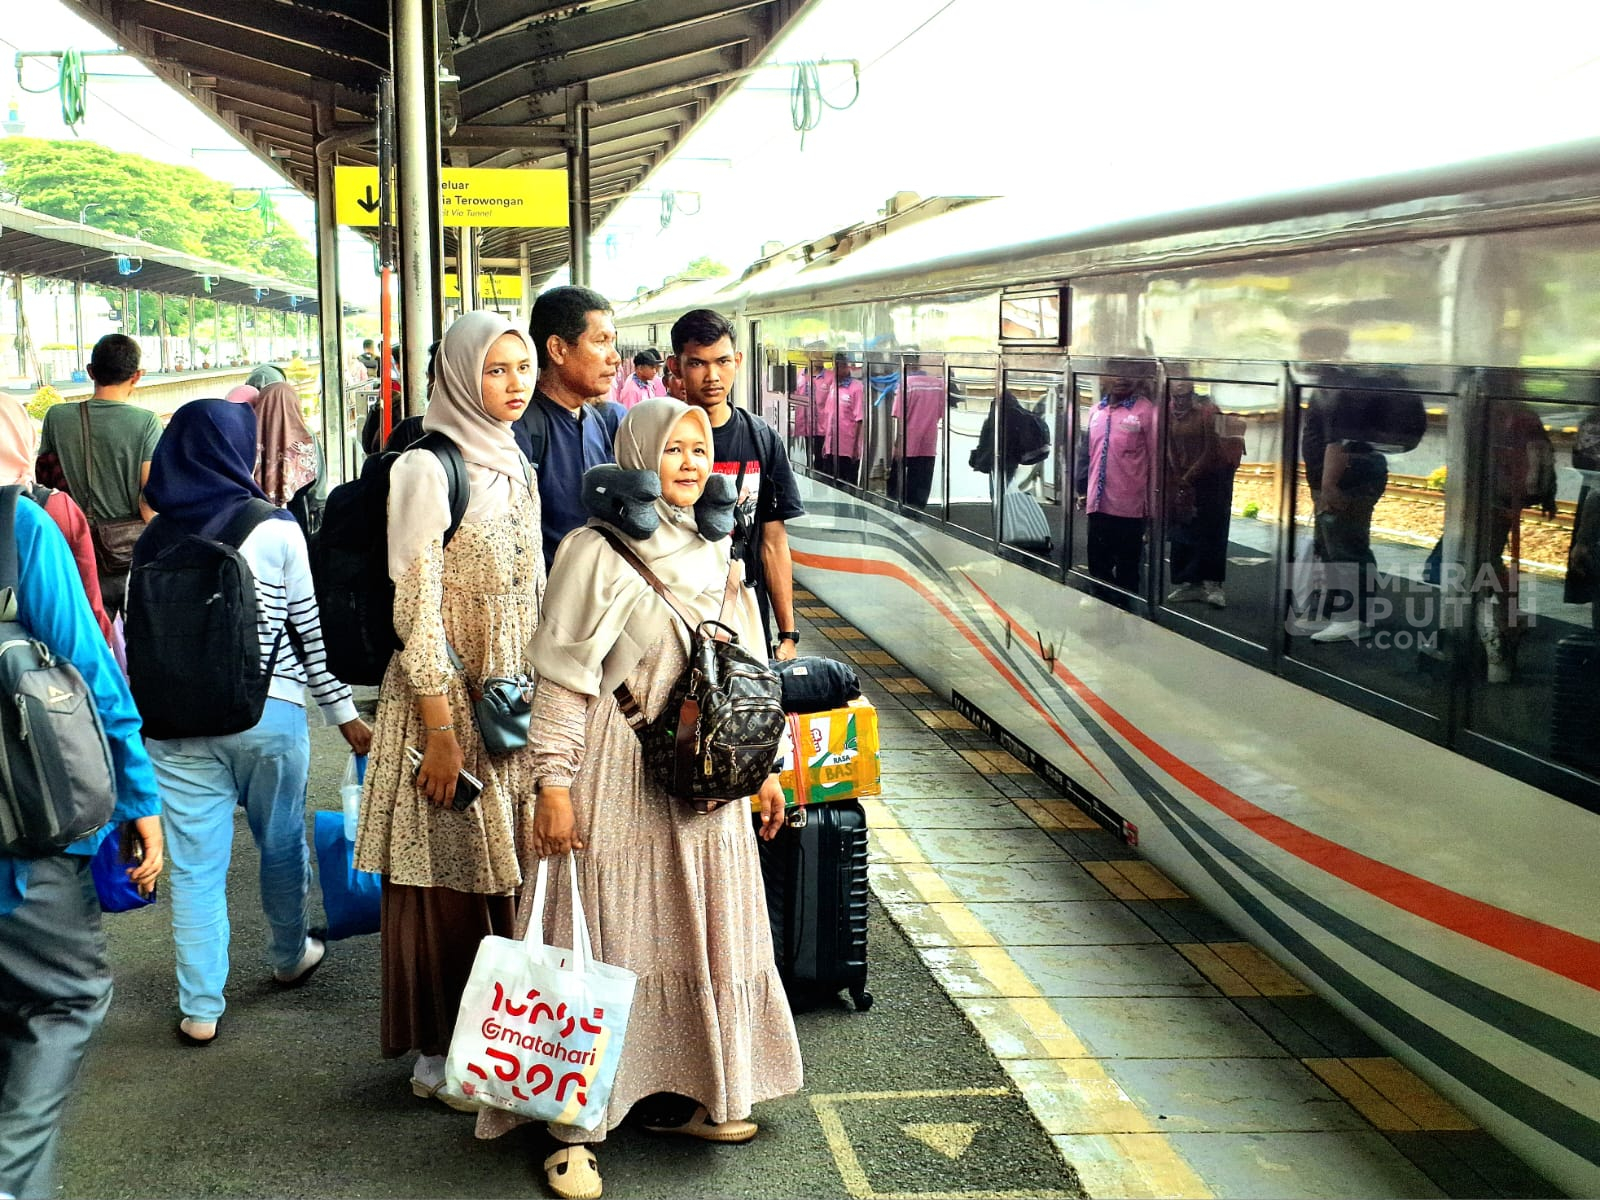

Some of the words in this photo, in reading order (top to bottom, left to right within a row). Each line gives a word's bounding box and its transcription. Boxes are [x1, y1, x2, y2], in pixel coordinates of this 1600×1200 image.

[441, 180, 469, 190] eluar
[442, 195, 452, 205] ia
[454, 195, 524, 208] Terowongan
[467, 209, 493, 217] Tunnel
[833, 754, 851, 764] RASA
[825, 763, 858, 781] BAS
